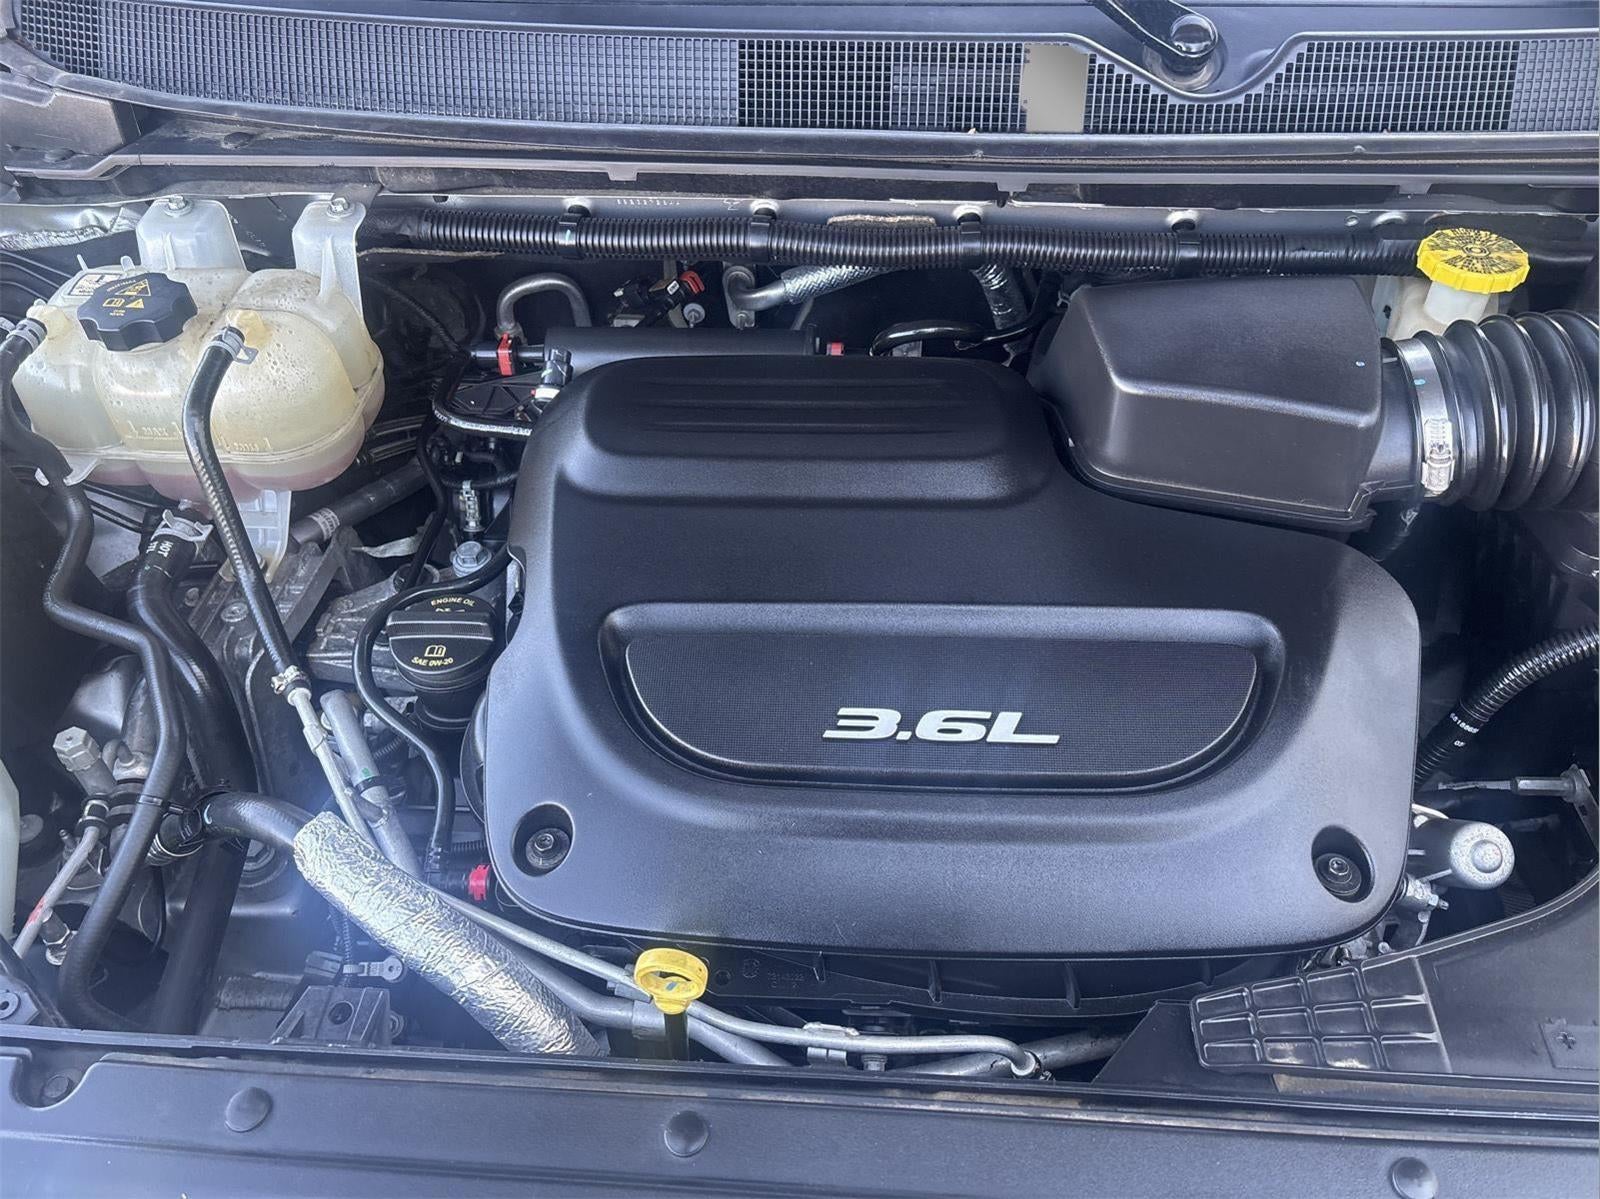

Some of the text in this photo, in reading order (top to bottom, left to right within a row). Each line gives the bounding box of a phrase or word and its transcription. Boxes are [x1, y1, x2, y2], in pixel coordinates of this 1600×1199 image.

[157, 540, 174, 558] HOT
[431, 598, 474, 606] ENGINE OIL
[411, 656, 428, 665] SAE
[822, 707, 1061, 744] 3.6L
